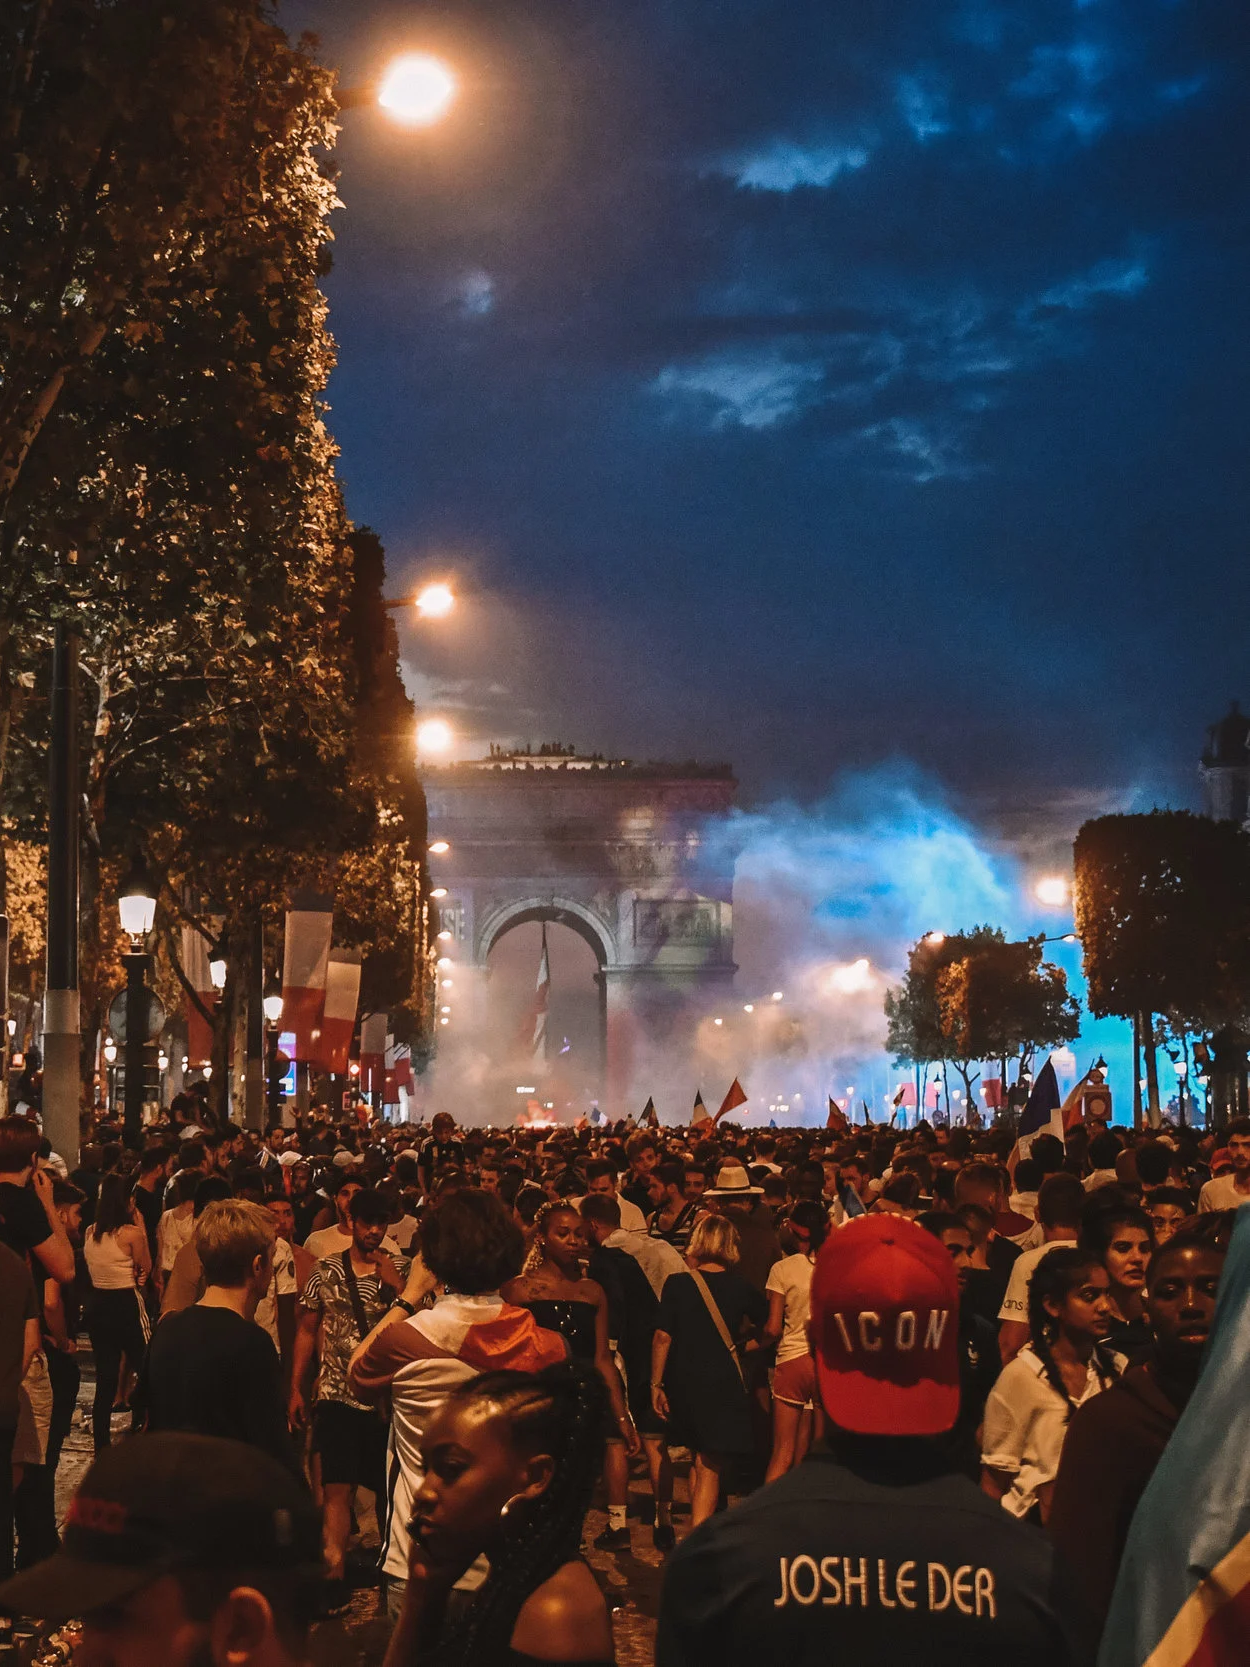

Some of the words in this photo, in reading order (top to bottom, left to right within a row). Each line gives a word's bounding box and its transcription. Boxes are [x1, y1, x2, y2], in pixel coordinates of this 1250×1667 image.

[833, 1309, 950, 1353] ICON
[773, 1553, 869, 1609] JOSH
[877, 1557, 918, 1609] LE
[926, 1560, 997, 1620] DER
